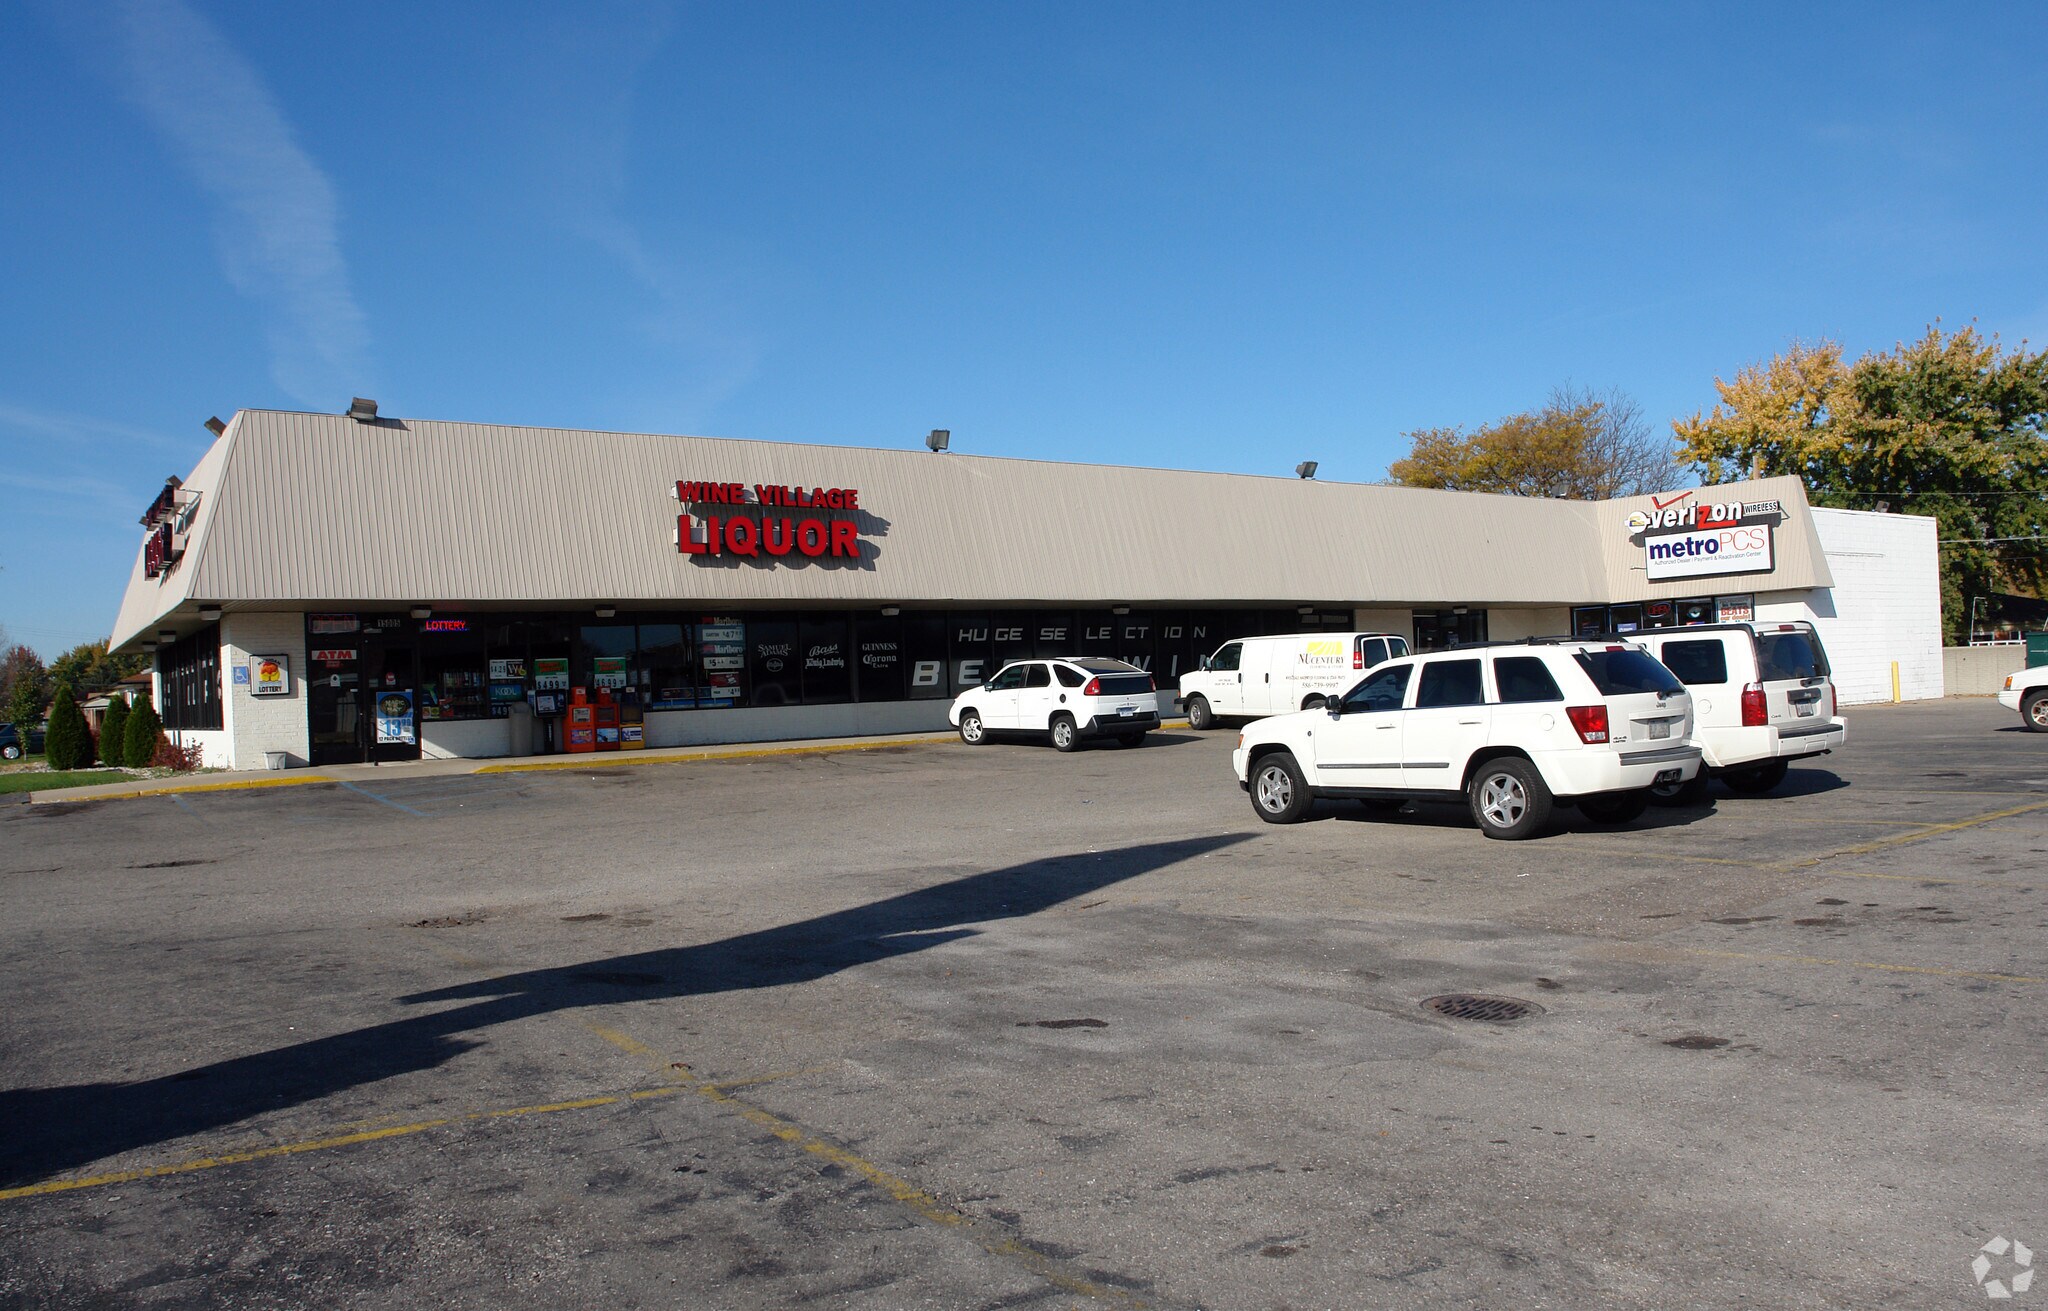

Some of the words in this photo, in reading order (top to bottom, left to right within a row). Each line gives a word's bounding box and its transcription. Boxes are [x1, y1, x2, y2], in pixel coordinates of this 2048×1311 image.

[677, 480, 745, 504] WINE
[754, 484, 859, 510] VILLAGE
[1650, 501, 1743, 530] verizon
[1744, 501, 1778, 514] WIRELESS
[678, 514, 860, 558] LIQUOR
[1649, 528, 1766, 560] metroPCS
[425, 620, 466, 631] LOTTERY
[713, 616, 742, 626] Marlboro
[958, 627, 1023, 643] HUGE
[714, 644, 744, 655] Marlboro
[758, 643, 791, 655] SAMUEL
[808, 643, 840, 657] Bass
[862, 643, 898, 651] GUINNESS
[316, 650, 353, 659] ATM
[760, 651, 789, 659] ADAMS
[862, 653, 897, 665] Corona
[495, 686, 517, 696] KOOL
